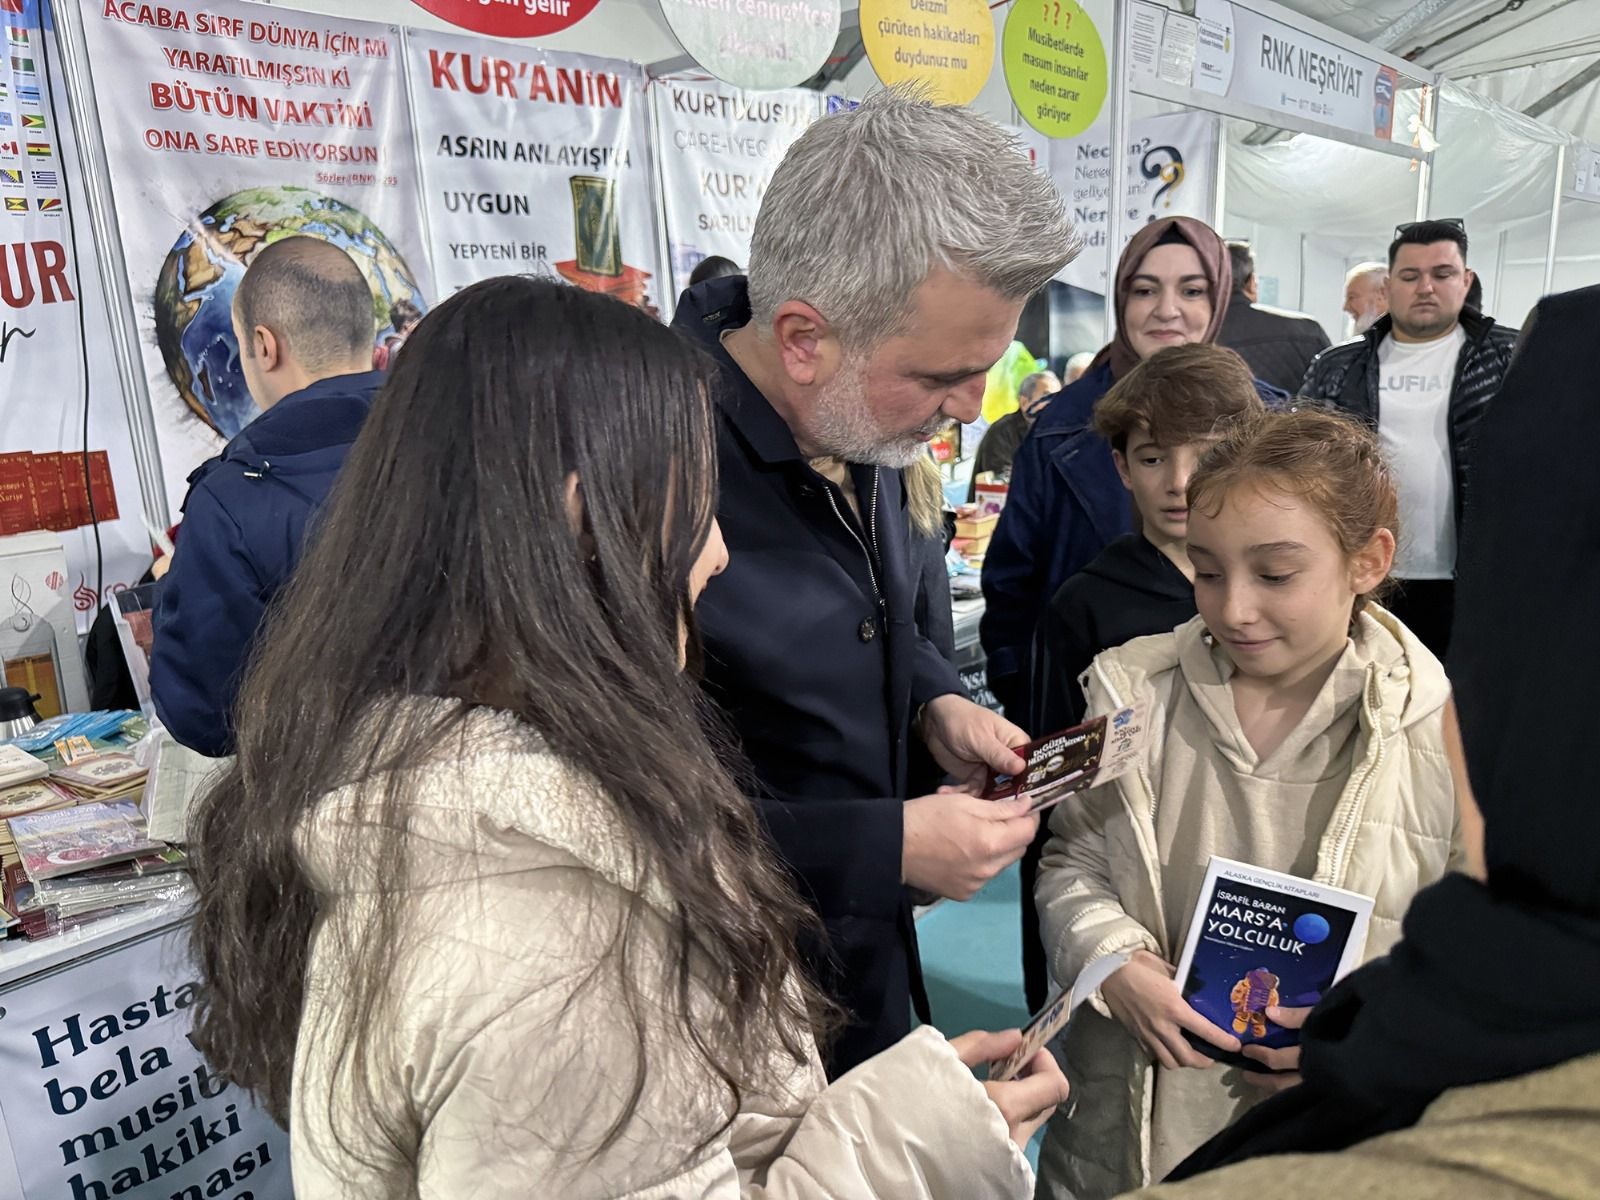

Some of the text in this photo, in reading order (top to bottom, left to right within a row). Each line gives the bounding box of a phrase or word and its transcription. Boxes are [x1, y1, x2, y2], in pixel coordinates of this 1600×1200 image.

[104, 0, 190, 31] ACABA
[250, 21, 319, 49] DÜNYA
[324, 29, 360, 56] İÇİN
[878, 17, 980, 46] çürüten hakikatları
[1027, 26, 1085, 58] Musibetlerde
[894, 47, 968, 70] duydunuz mu
[1021, 52, 1089, 82] masum insanlar
[1260, 34, 1297, 78] RNK
[1298, 47, 1363, 98] NEŞRİYAT
[331, 66, 351, 87] Kİ
[1029, 78, 1080, 102] neden zarar
[150, 80, 373, 128] BÜTÜN VAKTİNİ
[1036, 104, 1072, 124] görüyor
[145, 128, 200, 151] ONA
[205, 133, 259, 156] SARF
[265, 138, 379, 162] EDİYORSUN
[437, 134, 507, 161] ASRIN
[443, 191, 531, 215] UYGUN
[449, 241, 547, 261] YEPYENİ BİR
[1224, 869, 1252, 882] ALASKA
[1253, 877, 1283, 890] GENÇLİK
[1216, 889, 1286, 914] İSRAFİL BARAN
[1210, 902, 1283, 932] MARS'A
[1208, 918, 1306, 956] YOLCULUK
[32, 982, 203, 1069] Hasta
[43, 1045, 173, 1116] bela
[67, 1103, 243, 1200] hakiki
